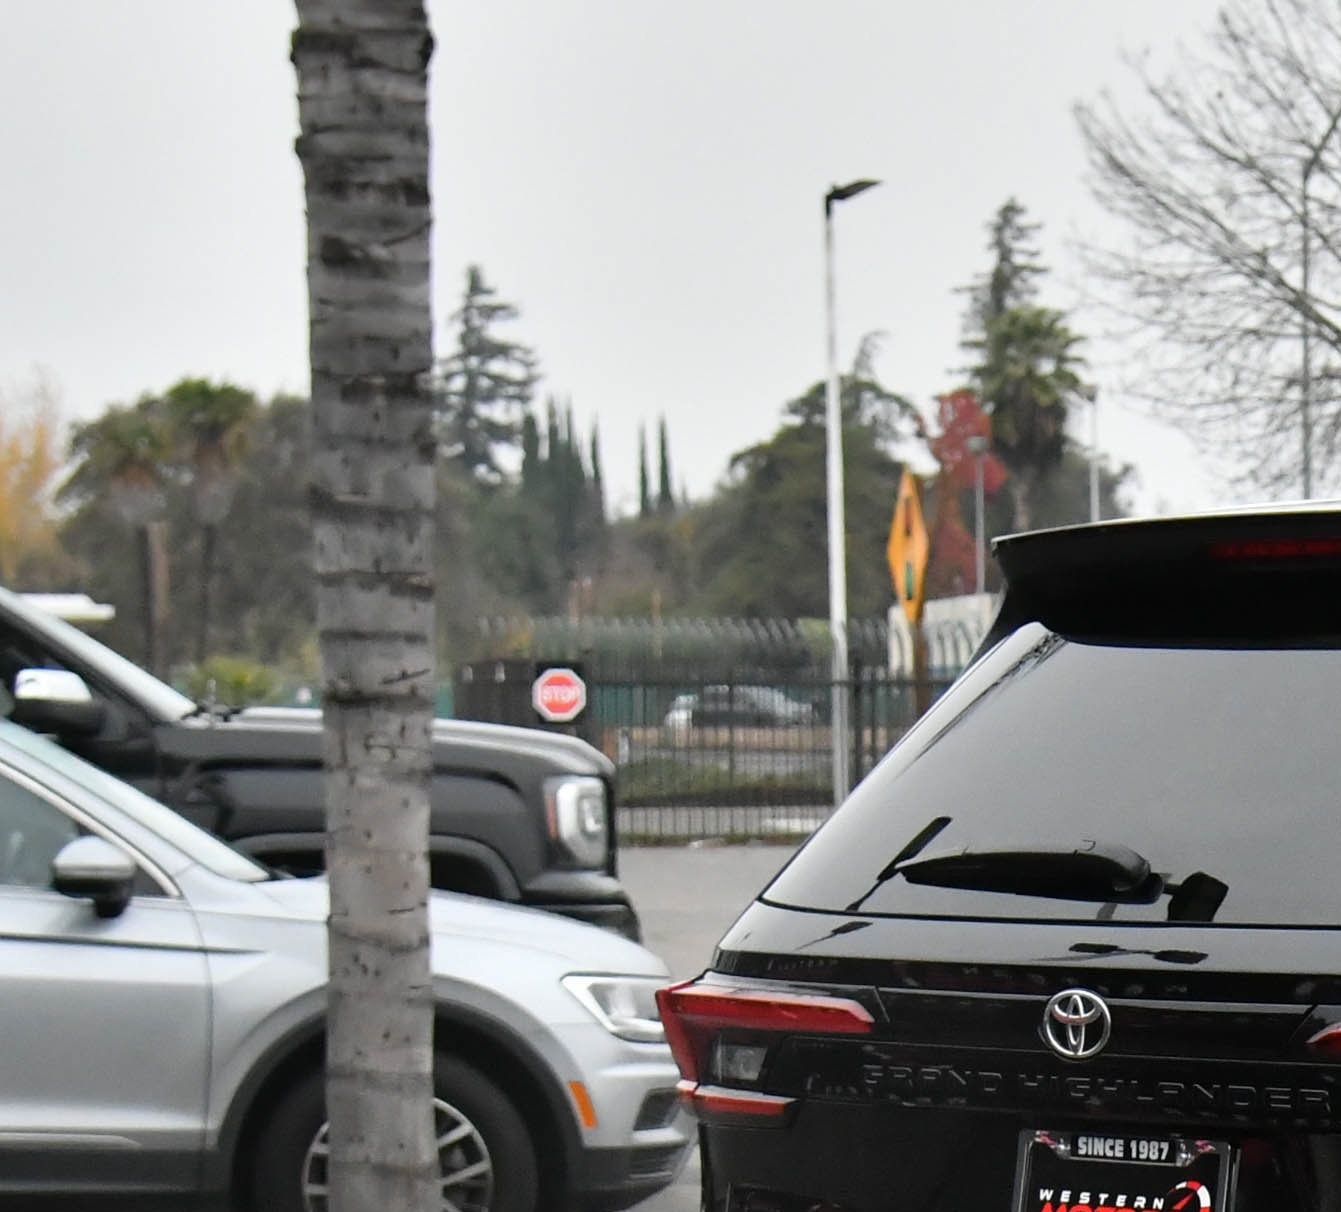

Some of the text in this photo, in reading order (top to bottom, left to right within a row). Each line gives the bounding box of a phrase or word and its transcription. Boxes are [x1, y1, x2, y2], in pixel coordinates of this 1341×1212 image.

[542, 685, 580, 704] STOP
[862, 1063, 1332, 1113] GRAND HIGHLANDER
[1077, 1136, 1169, 1160] SINCE 1987
[1039, 1188, 1164, 1210] WESTERN
